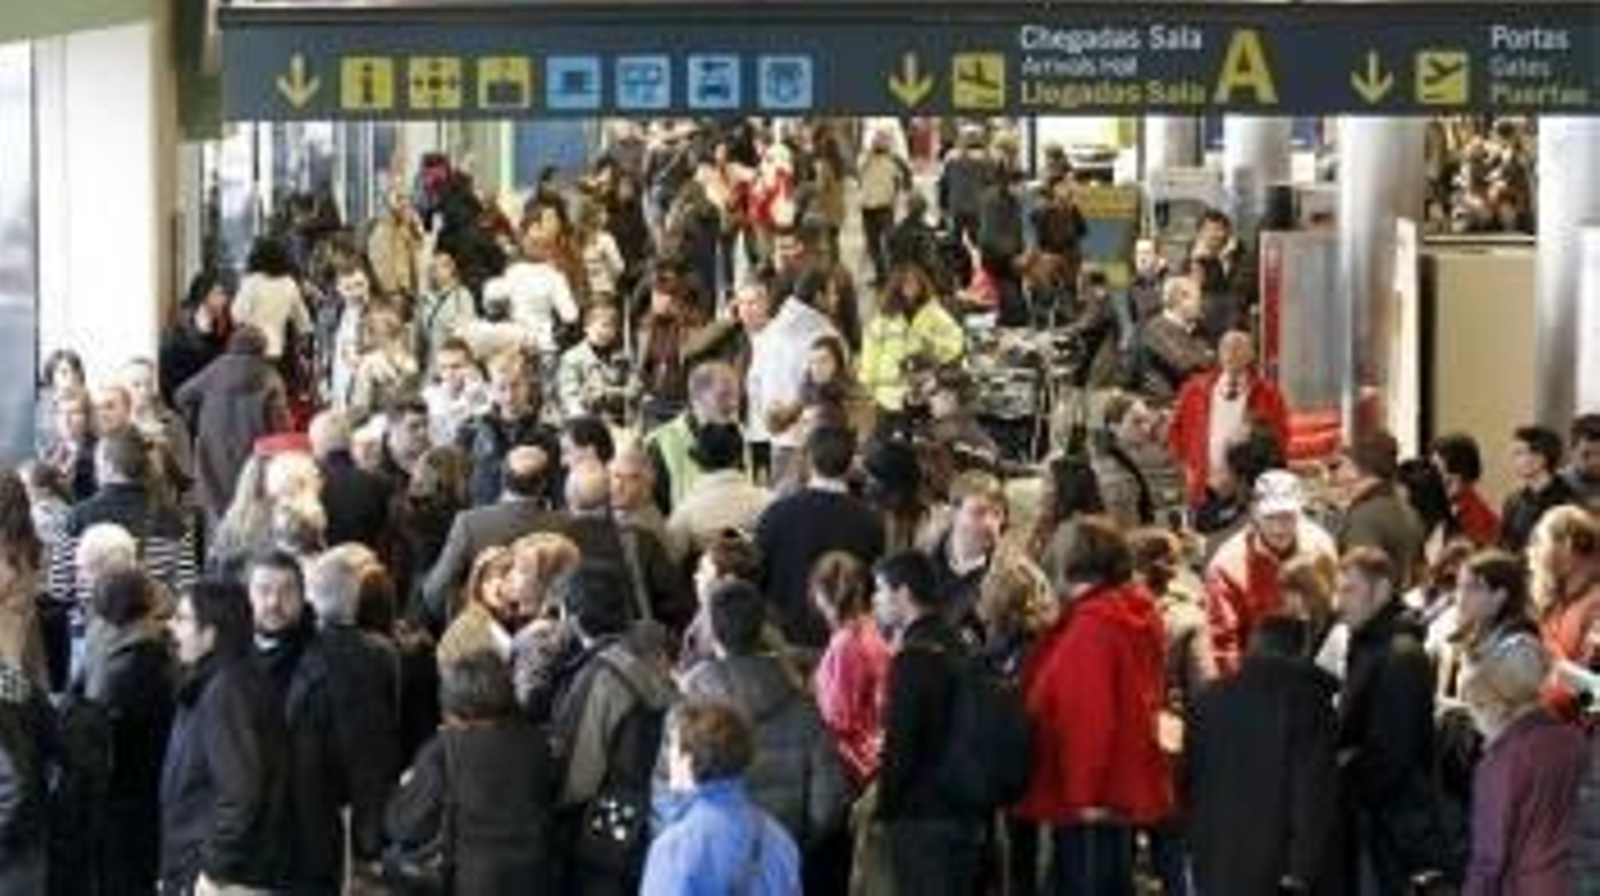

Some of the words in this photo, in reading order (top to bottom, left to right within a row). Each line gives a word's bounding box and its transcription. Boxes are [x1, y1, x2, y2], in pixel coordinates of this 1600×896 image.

[1021, 25, 1140, 53] Chegadas
[1149, 25, 1203, 50] Sala
[1491, 25, 1571, 50] Portas
[1022, 55, 1095, 76] Arrivals
[1099, 55, 1138, 76] Hall
[1213, 28, 1279, 104] A
[1021, 80, 1141, 106] Llegadas
[1146, 80, 1205, 104] Sala
